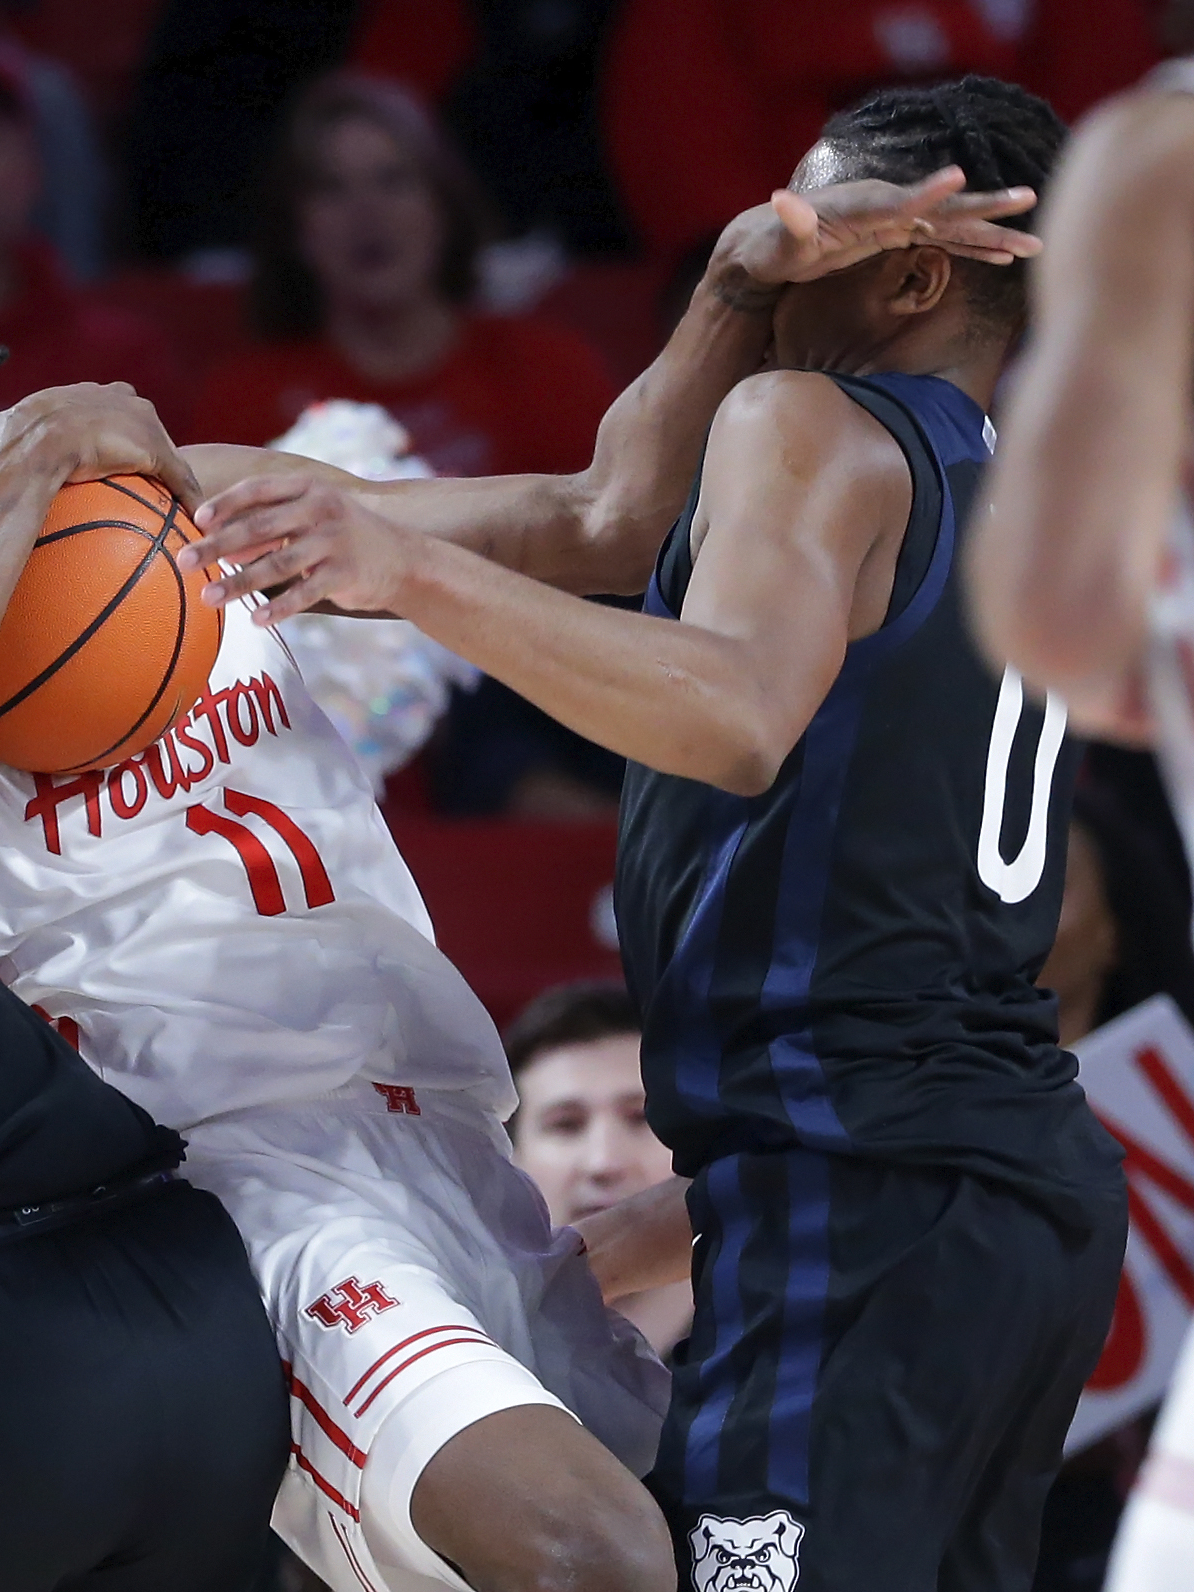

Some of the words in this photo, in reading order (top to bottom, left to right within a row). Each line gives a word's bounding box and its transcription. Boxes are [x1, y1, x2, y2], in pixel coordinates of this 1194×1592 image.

[24, 670, 292, 855] Houston
[185, 786, 336, 917] 11
[305, 1275, 401, 1335] UH
